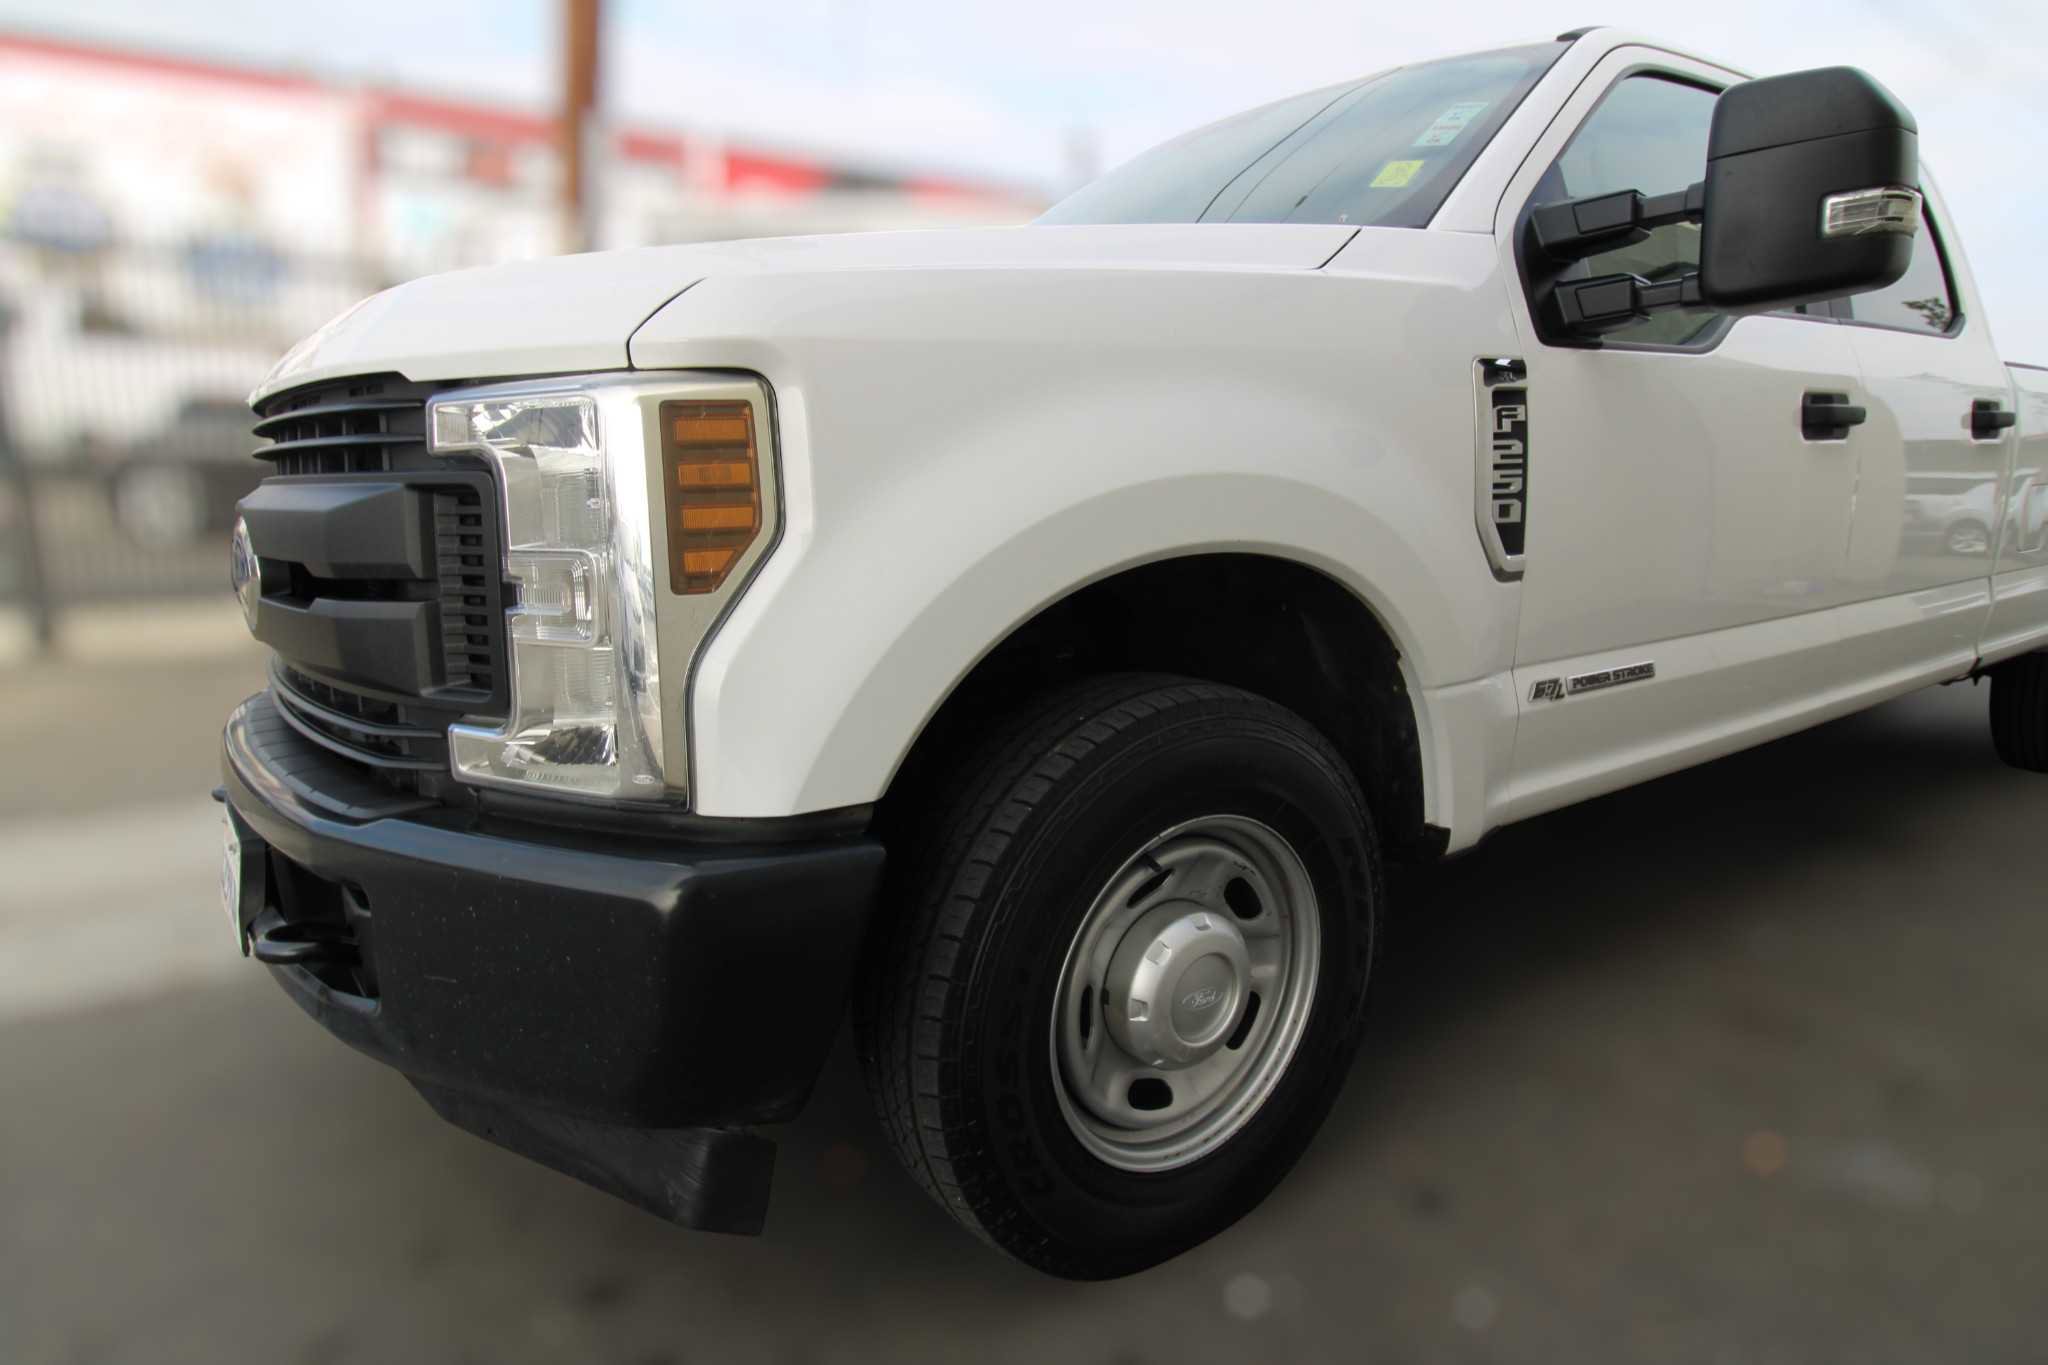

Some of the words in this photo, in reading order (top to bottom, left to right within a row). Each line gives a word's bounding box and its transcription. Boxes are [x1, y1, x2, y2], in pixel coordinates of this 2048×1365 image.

[1572, 673, 1611, 689] POWER
[1613, 663, 1655, 681] STROKE
[1188, 987, 1219, 1009] Ford
